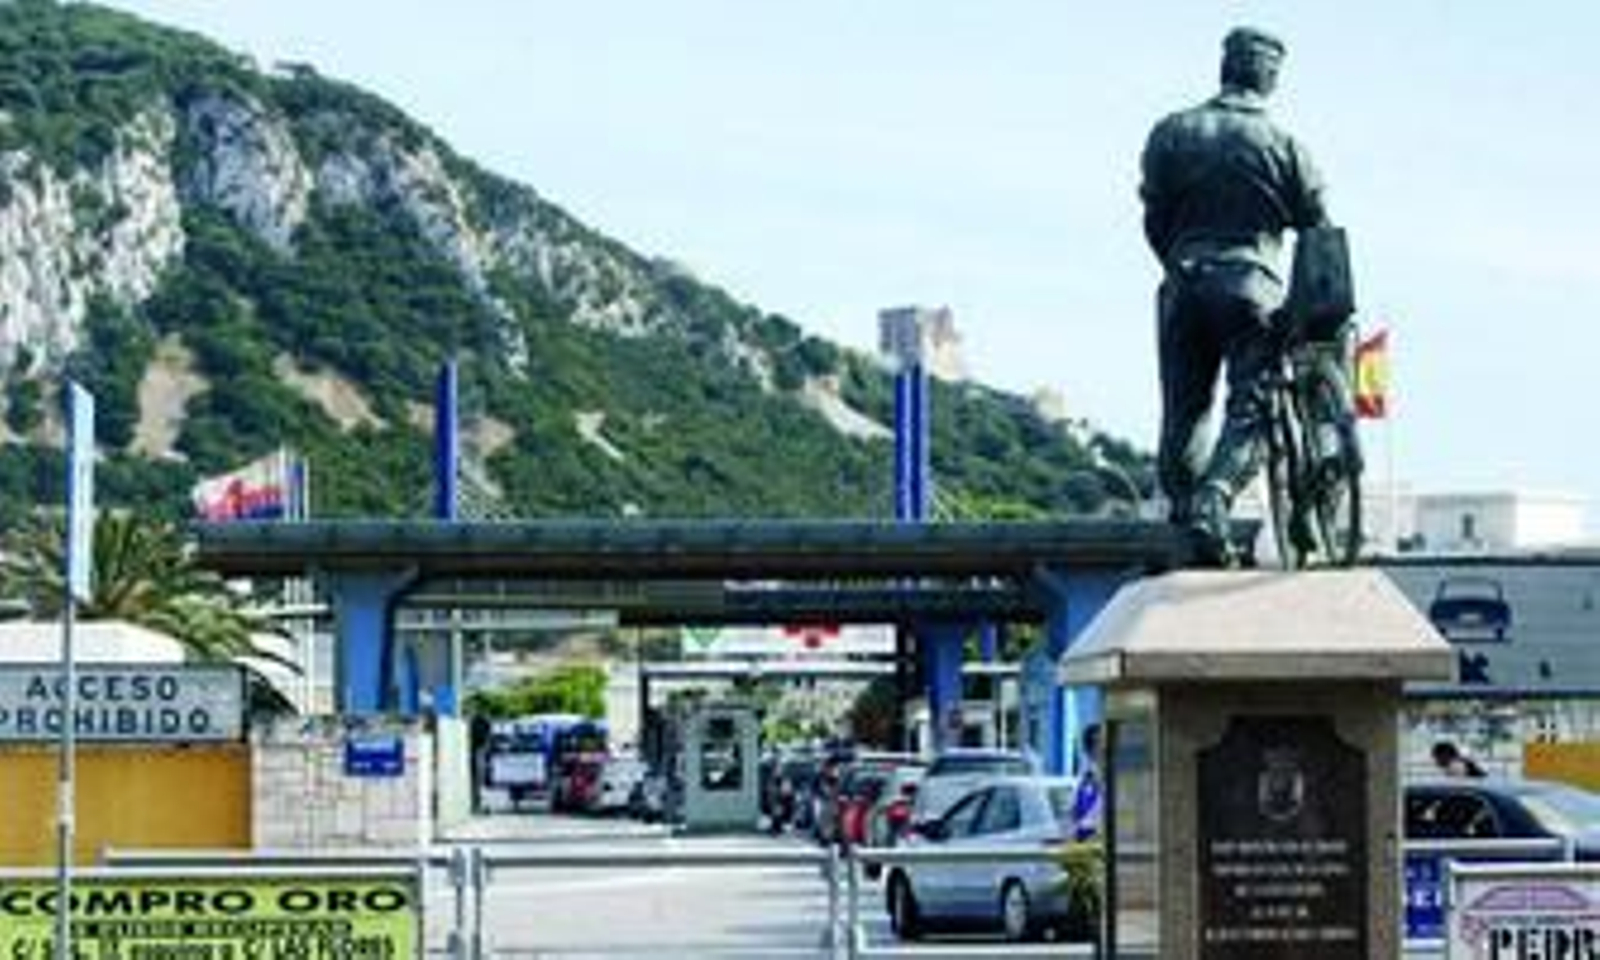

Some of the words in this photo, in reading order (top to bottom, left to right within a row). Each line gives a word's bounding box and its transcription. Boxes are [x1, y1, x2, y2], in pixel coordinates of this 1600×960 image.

[27, 675, 180, 701] ACCESO
[1, 889, 255, 916] COMPRO
[277, 889, 407, 915] ORO
